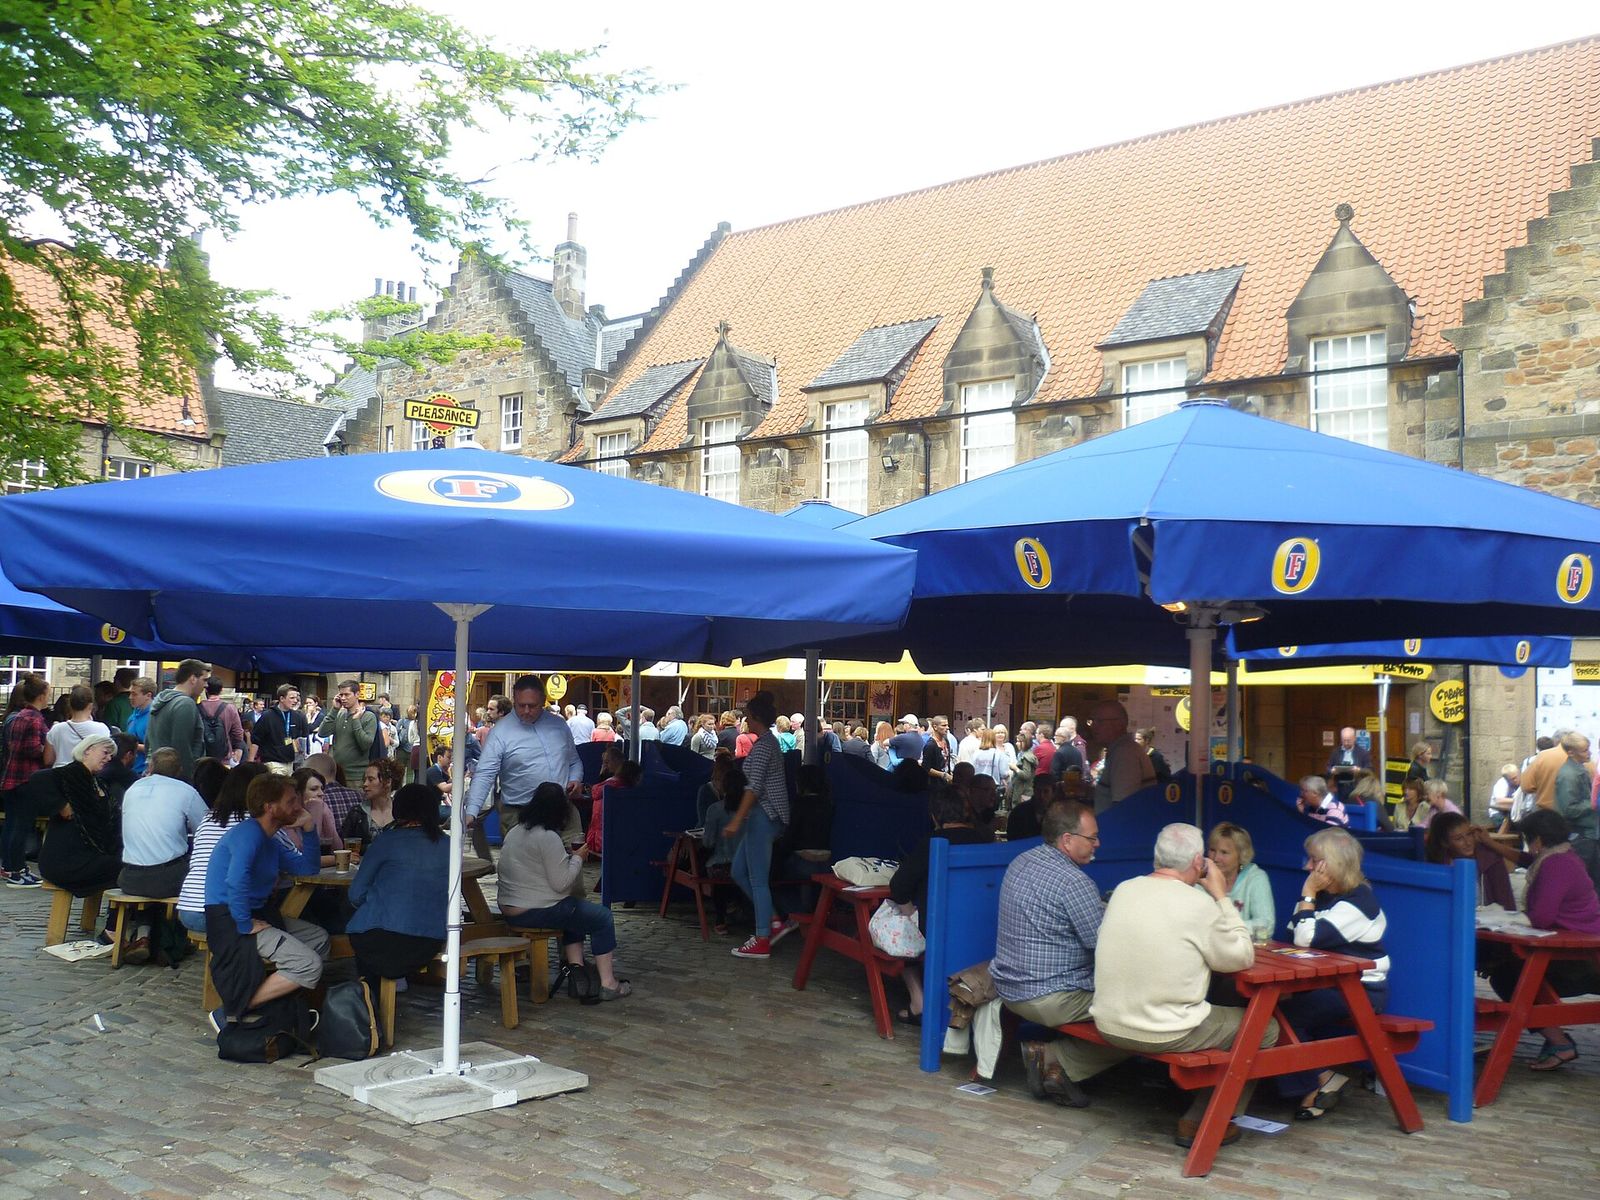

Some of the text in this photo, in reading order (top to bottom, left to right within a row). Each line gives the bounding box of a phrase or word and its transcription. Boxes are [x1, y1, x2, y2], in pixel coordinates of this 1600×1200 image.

[411, 405, 472, 424] PLEASANCE
[441, 479, 509, 498] F
[1025, 552, 1038, 575] F
[1286, 553, 1305, 579] F
[1567, 566, 1581, 590] F
[1383, 663, 1424, 676] BEYOND
[1436, 687, 1465, 701] CABARE
